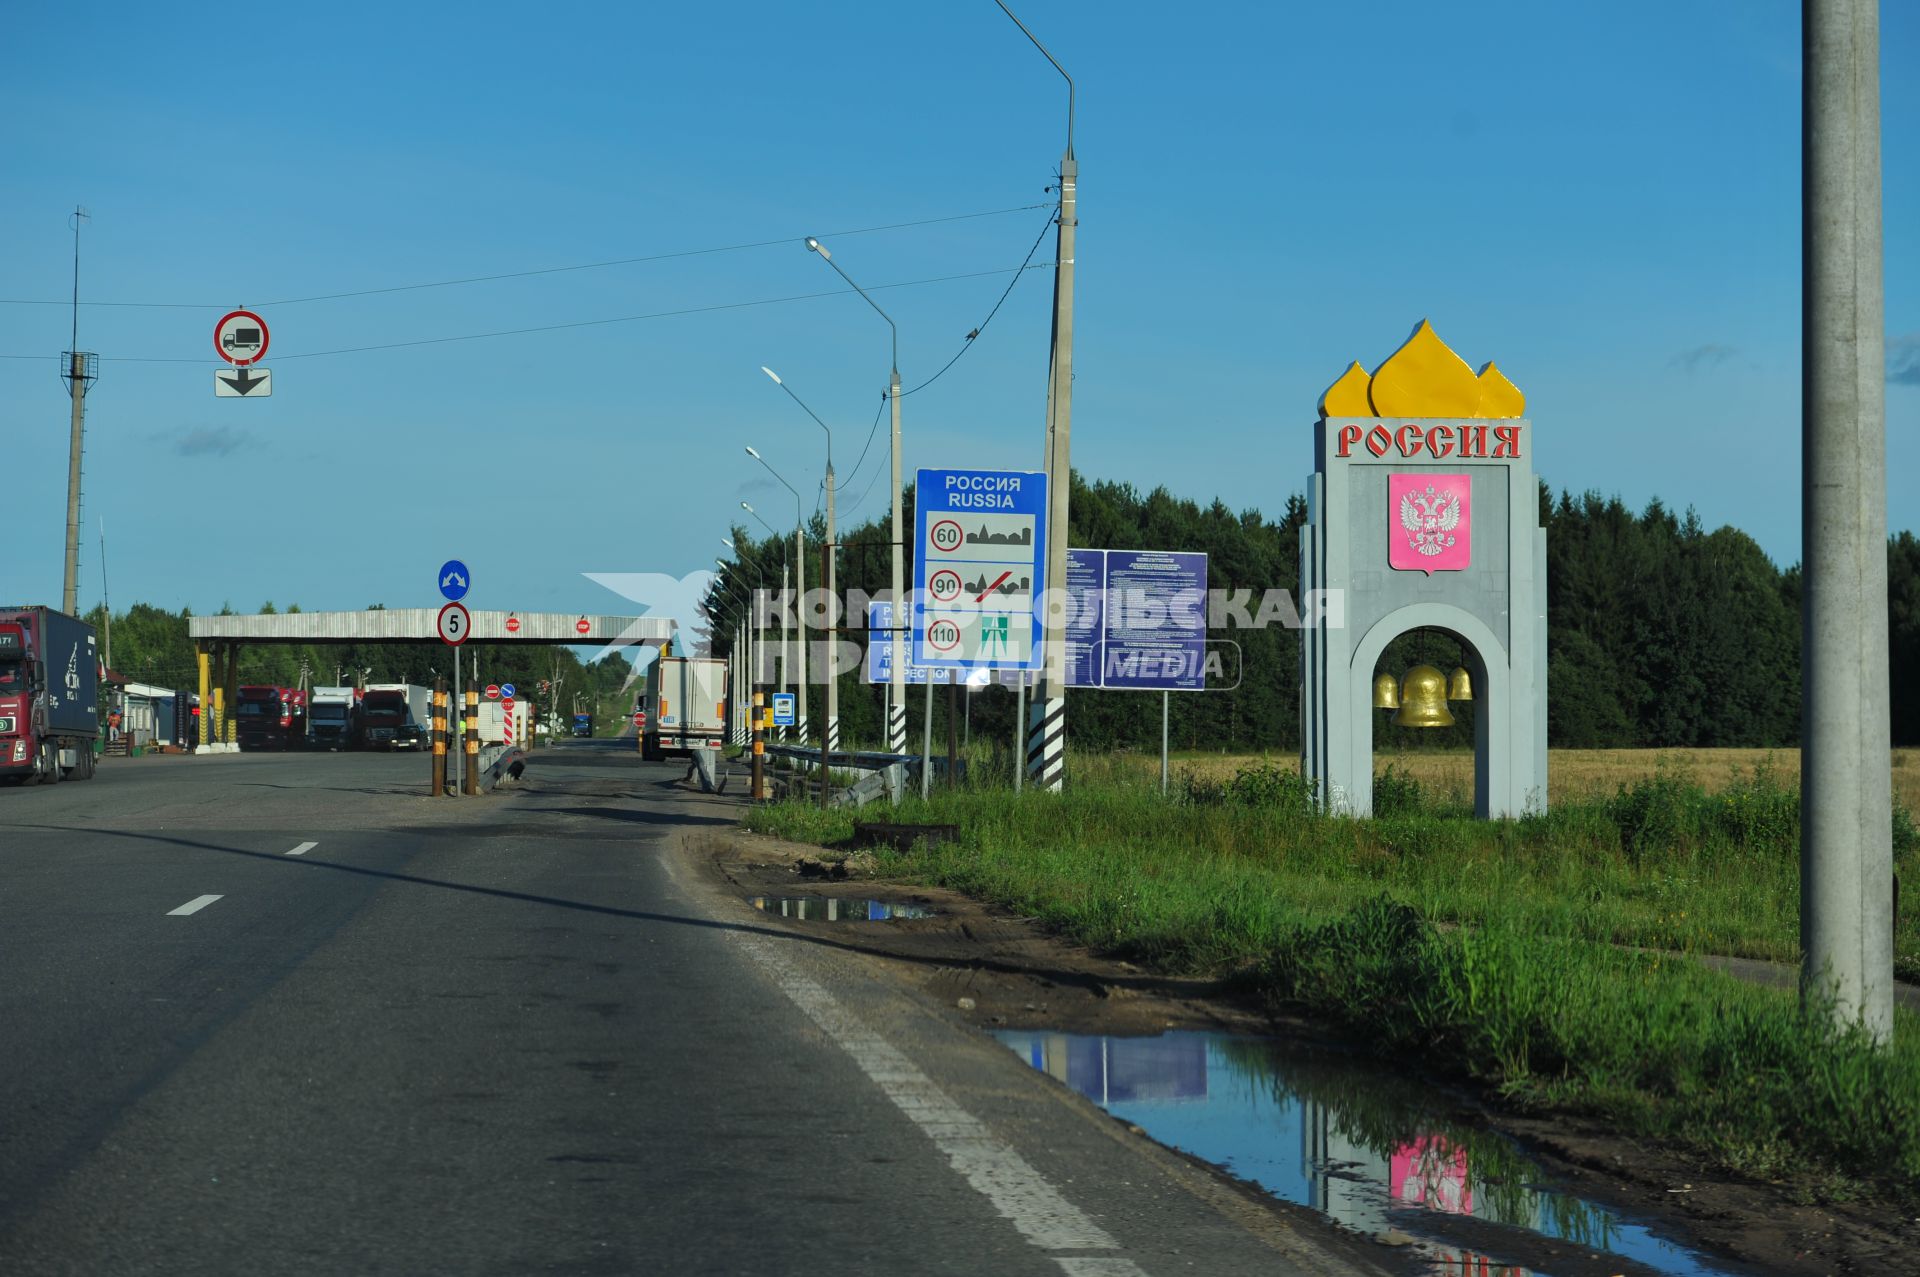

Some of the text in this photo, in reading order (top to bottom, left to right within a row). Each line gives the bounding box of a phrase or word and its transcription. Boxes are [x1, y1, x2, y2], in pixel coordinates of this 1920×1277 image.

[1335, 424, 1522, 459] РОССИЯ
[945, 476, 1021, 492] РОССИЯ
[949, 493, 1014, 508] RUSSIA
[936, 528, 957, 544] 60
[935, 579, 956, 594] 90
[449, 614, 459, 634] 5
[932, 628, 954, 643] 110
